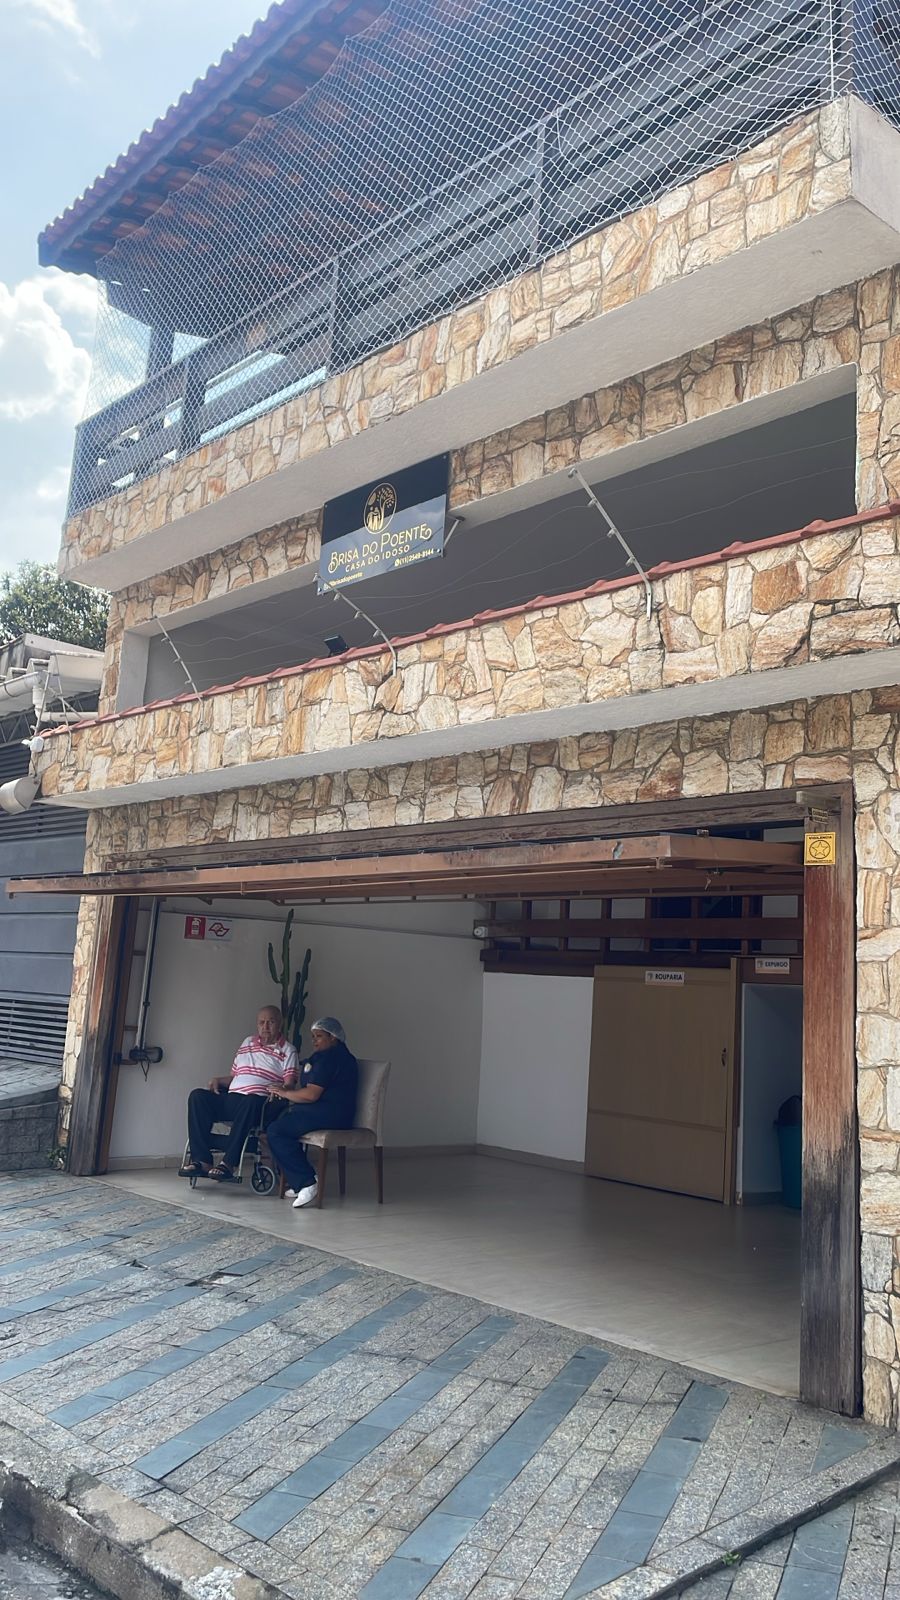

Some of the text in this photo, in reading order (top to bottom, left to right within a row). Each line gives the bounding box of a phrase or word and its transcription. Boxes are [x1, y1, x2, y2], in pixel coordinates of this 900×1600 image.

[328, 523, 432, 573] BRISA DO POENTE
[345, 545, 410, 572] CASA DO IDOSO
[655, 973, 682, 981] ROUPARIA
